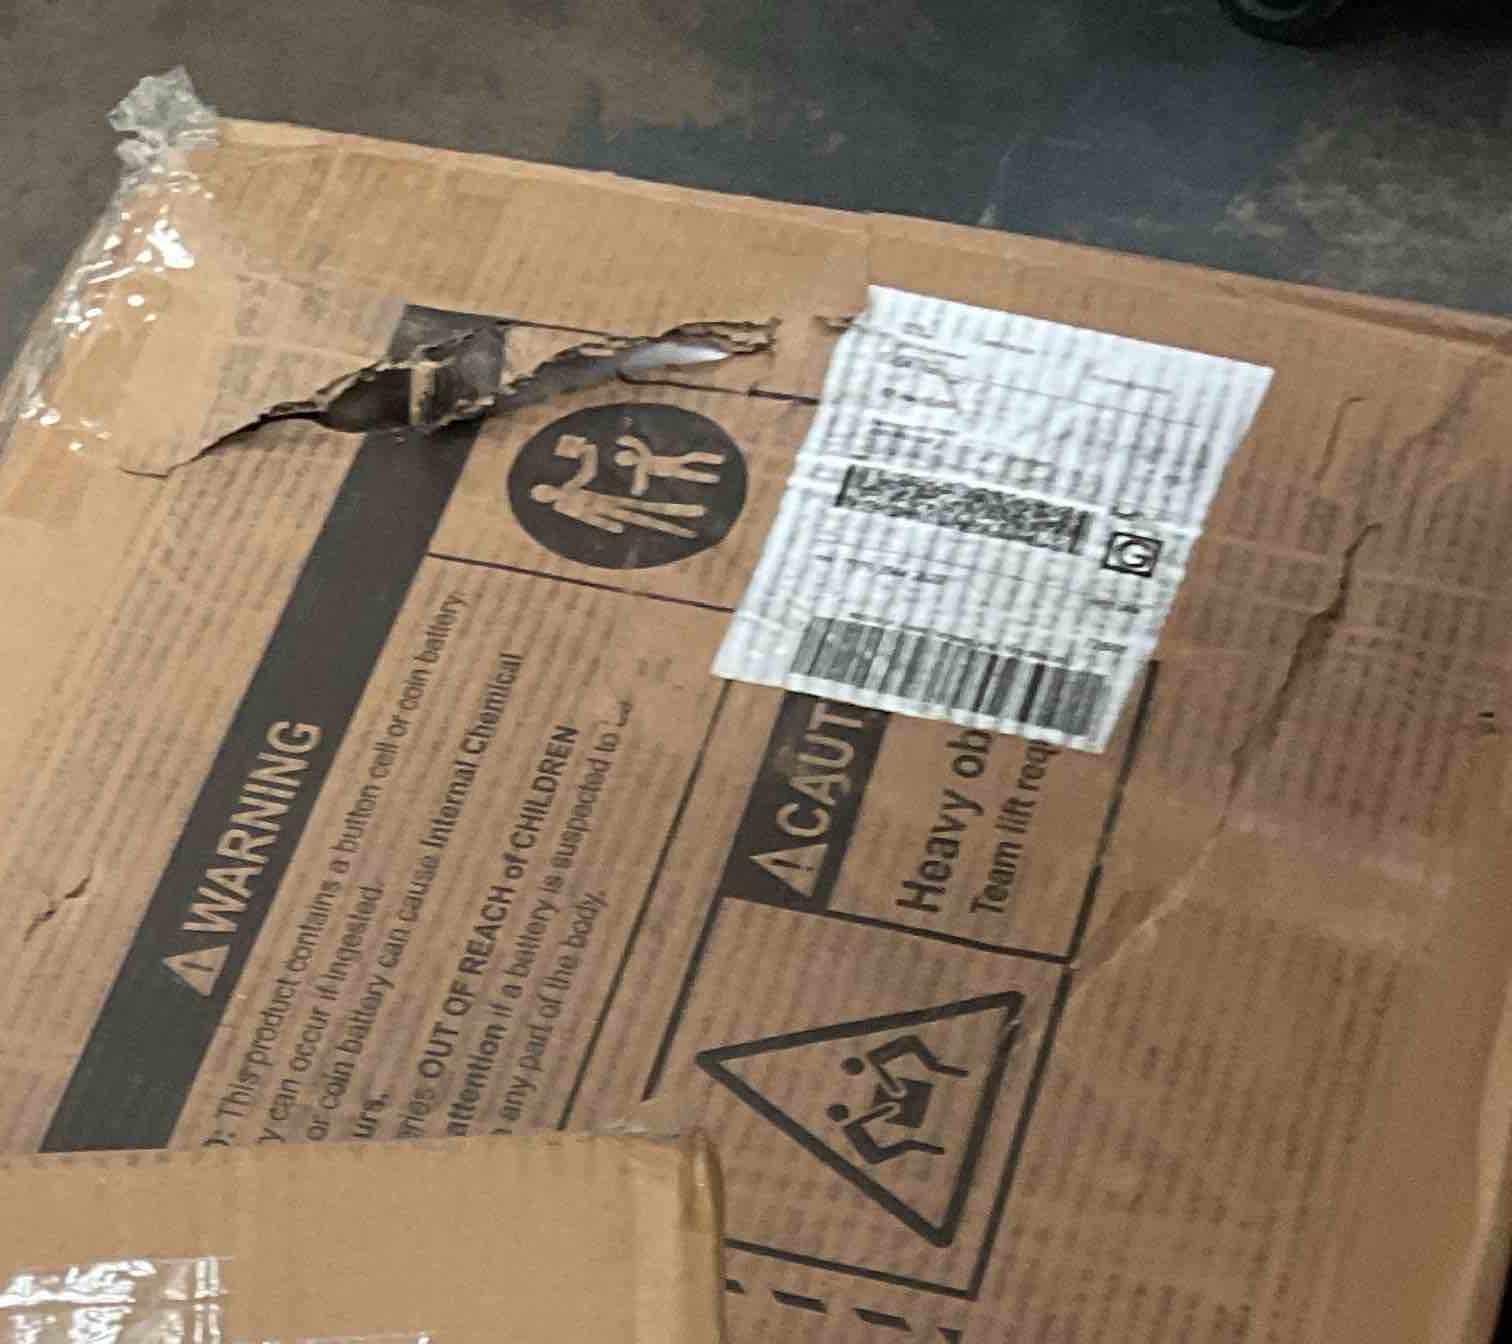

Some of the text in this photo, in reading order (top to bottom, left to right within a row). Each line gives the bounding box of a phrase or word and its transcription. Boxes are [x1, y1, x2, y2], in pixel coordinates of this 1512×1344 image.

[400, 667, 432, 711] coin
[388, 713, 411, 737] or
[594, 731, 621, 753] to
[369, 742, 397, 779] cell
[775, 701, 867, 838] CAUT
[182, 720, 322, 932] WARNING
[329, 784, 382, 853] button
[551, 757, 612, 870] suspected
[329, 858, 349, 874] a
[544, 874, 565, 893] is
[897, 788, 984, 912] Heavy
[970, 797, 1036, 914] Team lift
[287, 878, 340, 972] contains
[306, 652, 524, 1142] or coin battery can cause Internal Chemical
[418, 725, 579, 1079] OUT OF REACH of CHILDREN
[505, 898, 559, 978] battery
[544, 955, 581, 990] the
[247, 978, 299, 1066] product
[502, 985, 523, 999] a
[540, 995, 563, 1018] of
[269, 1078, 300, 1121] can
[289, 1006, 331, 1072] occur
[314, 982, 338, 1001] if
[447, 1025, 507, 1136] attention
[519, 1024, 554, 1072] part
[217, 1069, 259, 1117] This
[499, 1076, 537, 1121] any
